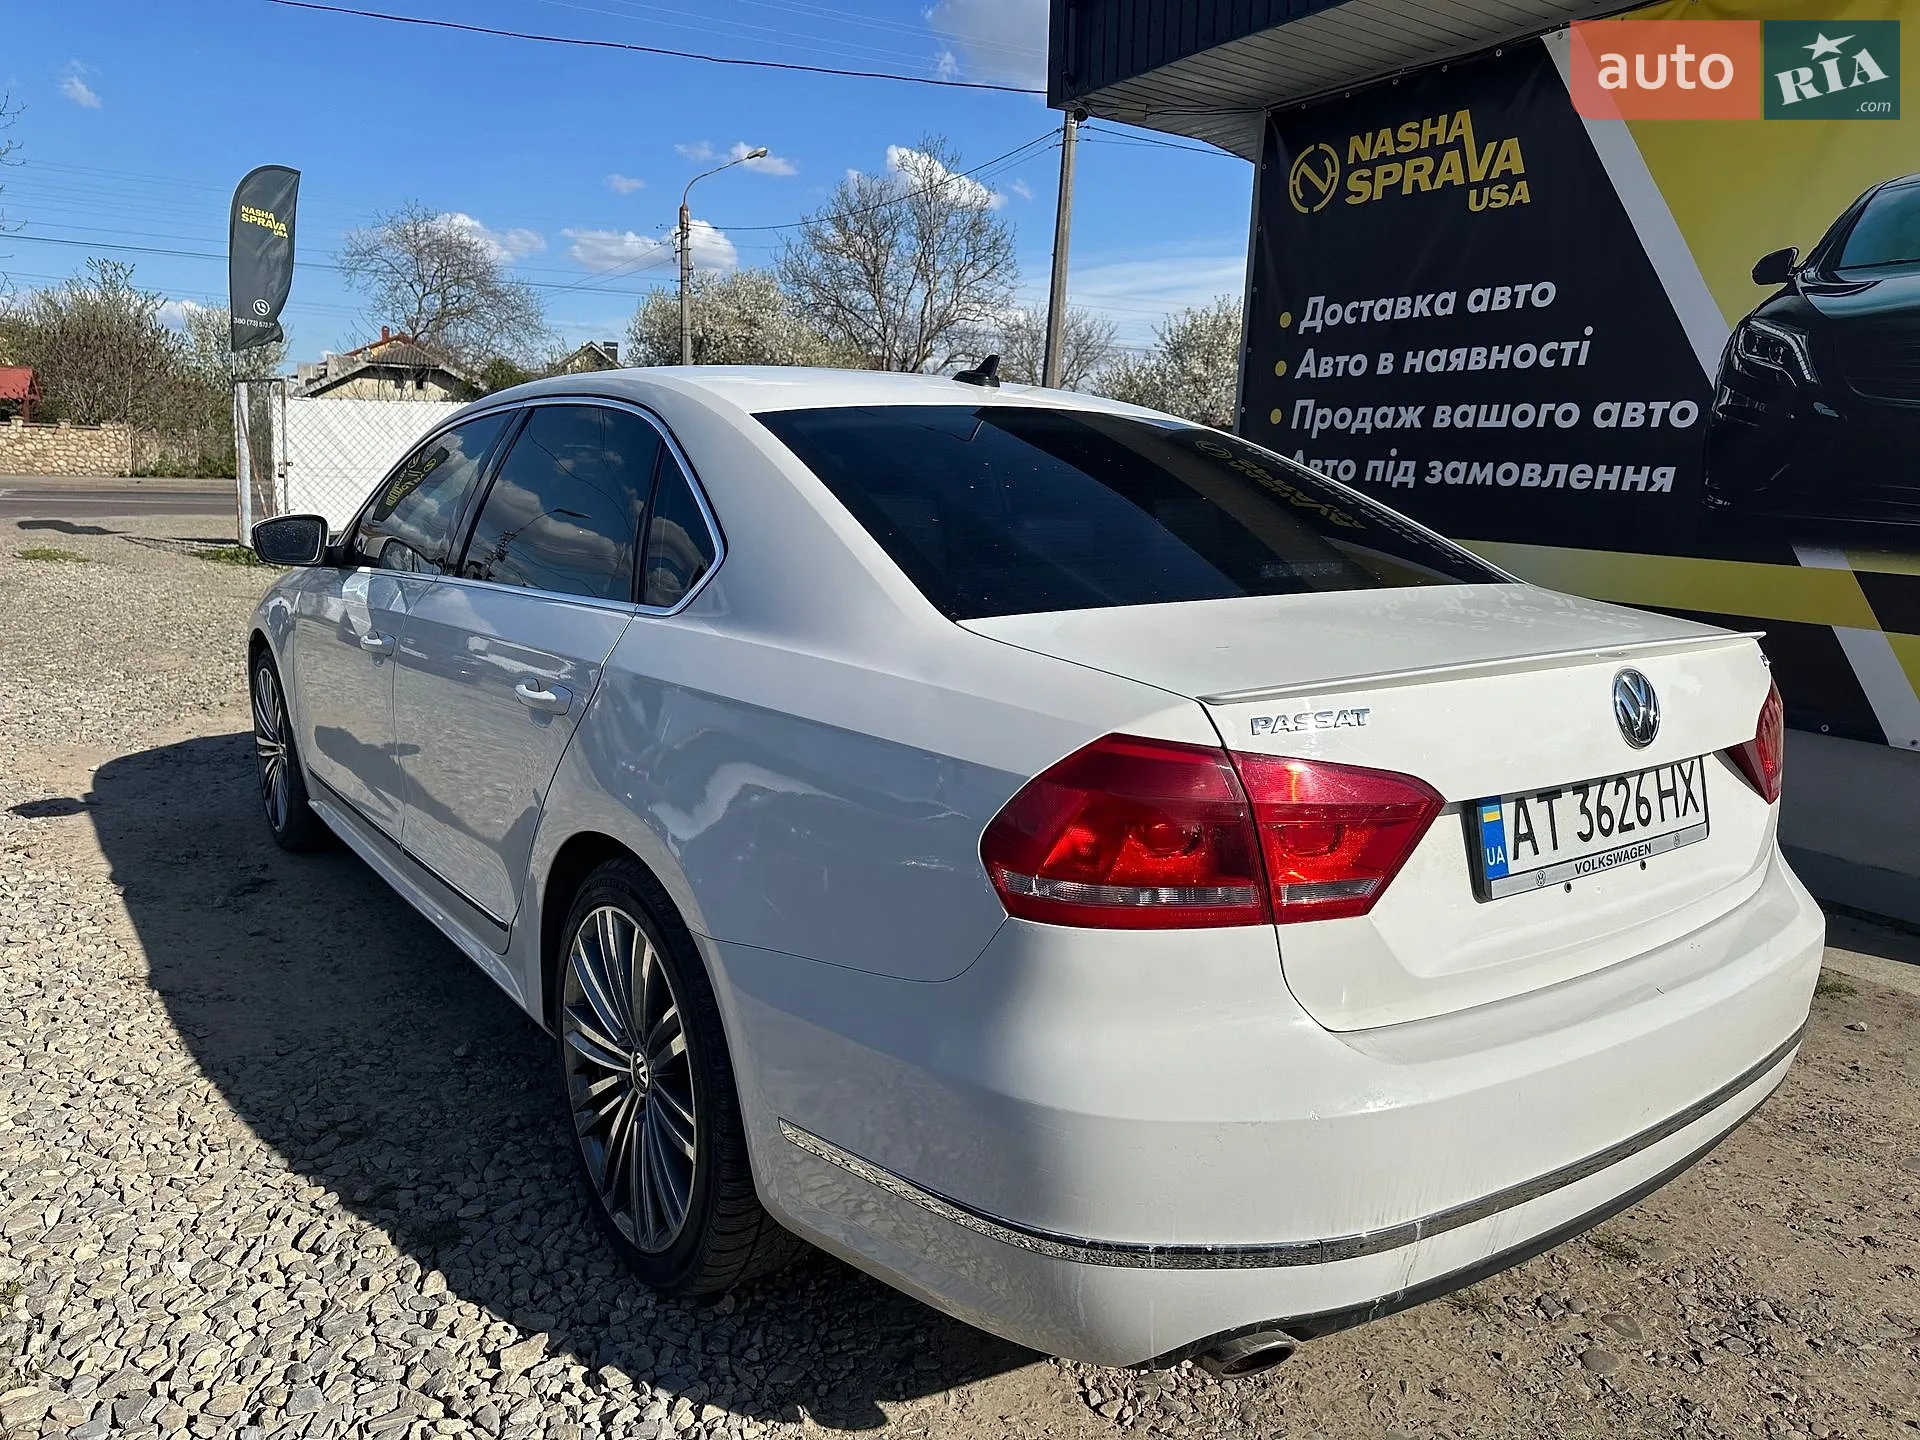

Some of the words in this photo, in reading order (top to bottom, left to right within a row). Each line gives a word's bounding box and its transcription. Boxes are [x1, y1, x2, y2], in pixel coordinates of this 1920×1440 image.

[1347, 109, 1470, 165] NASHA
[1345, 138, 1526, 205] SPRAVA
[241, 205, 275, 220] NASHA
[1468, 181, 1531, 212] USA
[241, 213, 287, 232] SPRAVA
[1298, 291, 1457, 334] Доставка
[1466, 281, 1557, 313] авто
[1294, 347, 1368, 379] Авто
[1376, 352, 1395, 375] в
[1403, 326, 1594, 374] наявності
[1291, 399, 1426, 439] Продаж
[1432, 401, 1581, 428] вашого
[1593, 400, 1699, 429] авто
[1365, 448, 1416, 488] під
[1424, 460, 1677, 493] замовлення
[1250, 708, 1371, 736] PASSAT
[1486, 847, 1506, 866] UA
[1513, 790, 1563, 861] AT
[1572, 772, 1652, 843] 3626
[1655, 761, 1700, 823] HX
[1574, 843, 1652, 875] VOLKSWAGEN
